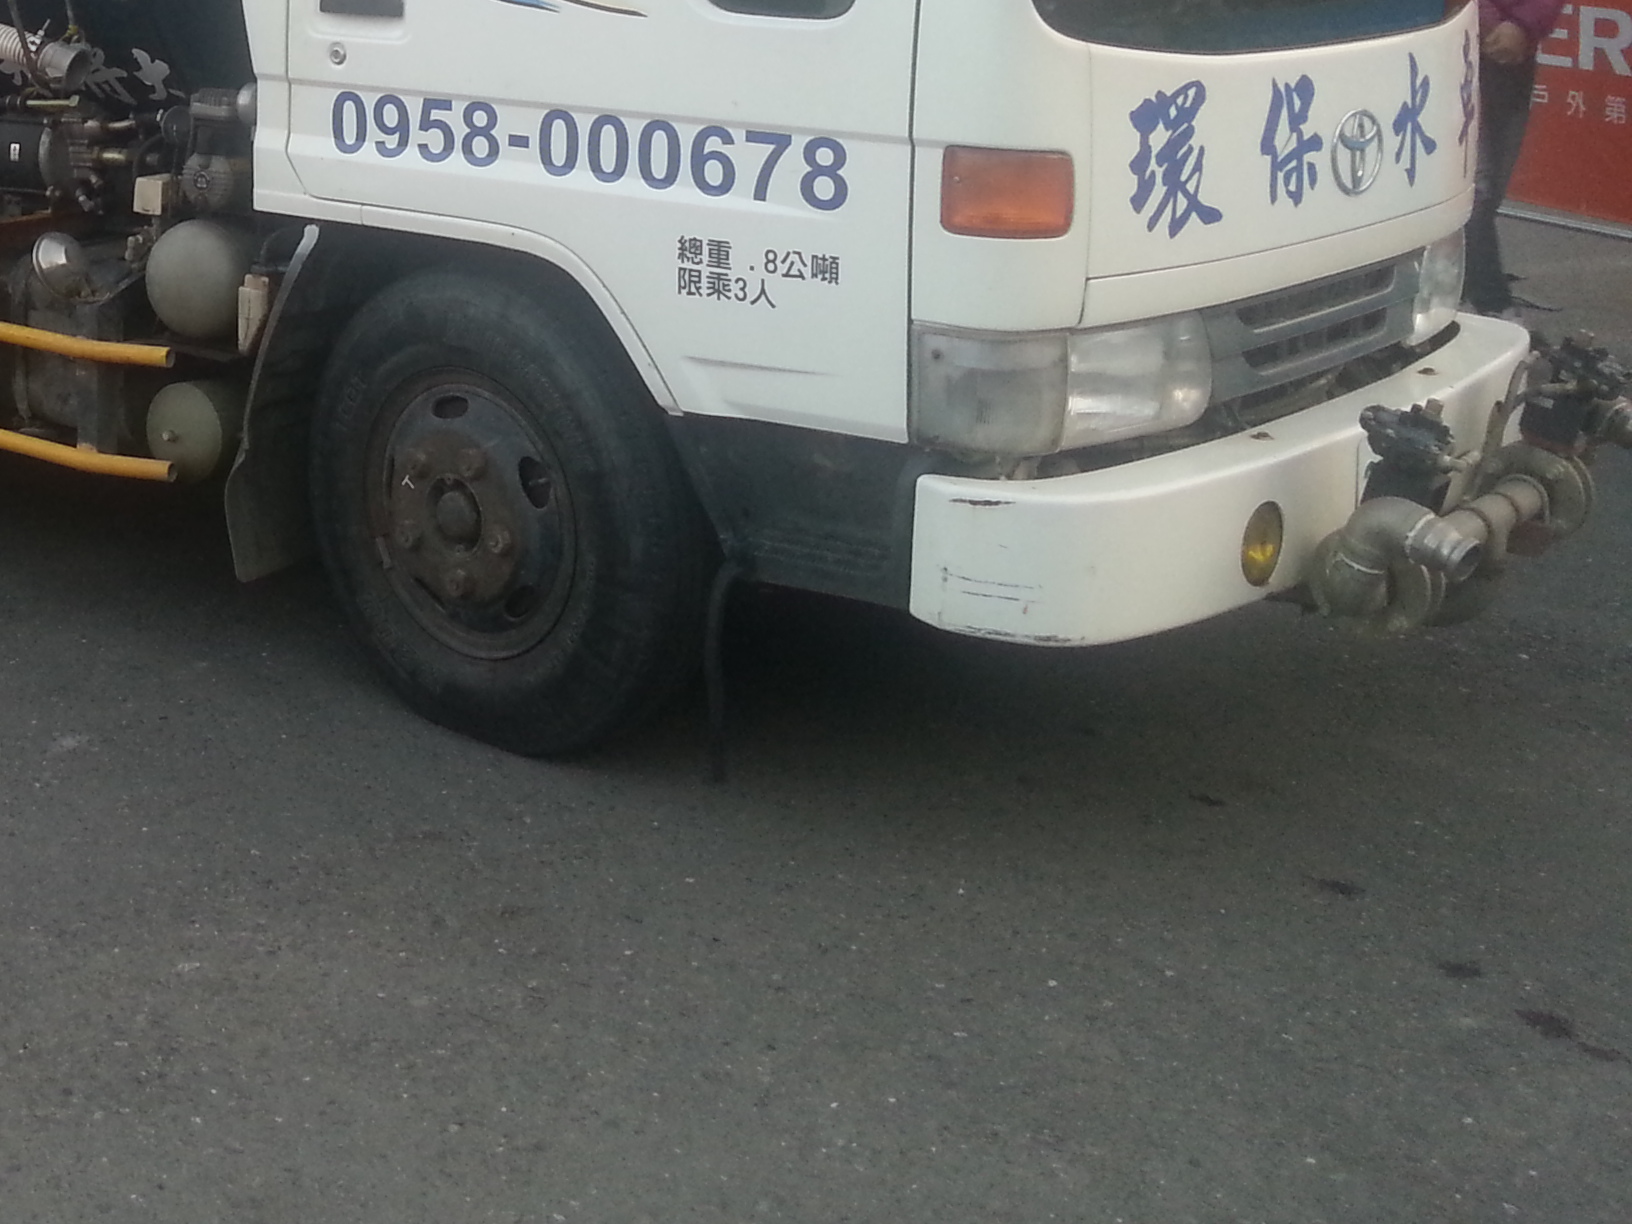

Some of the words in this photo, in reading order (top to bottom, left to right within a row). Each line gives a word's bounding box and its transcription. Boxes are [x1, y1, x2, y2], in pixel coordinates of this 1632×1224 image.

[331, 90, 850, 211] 0958-000678
[677, 267, 776, 309] 限乘3人
